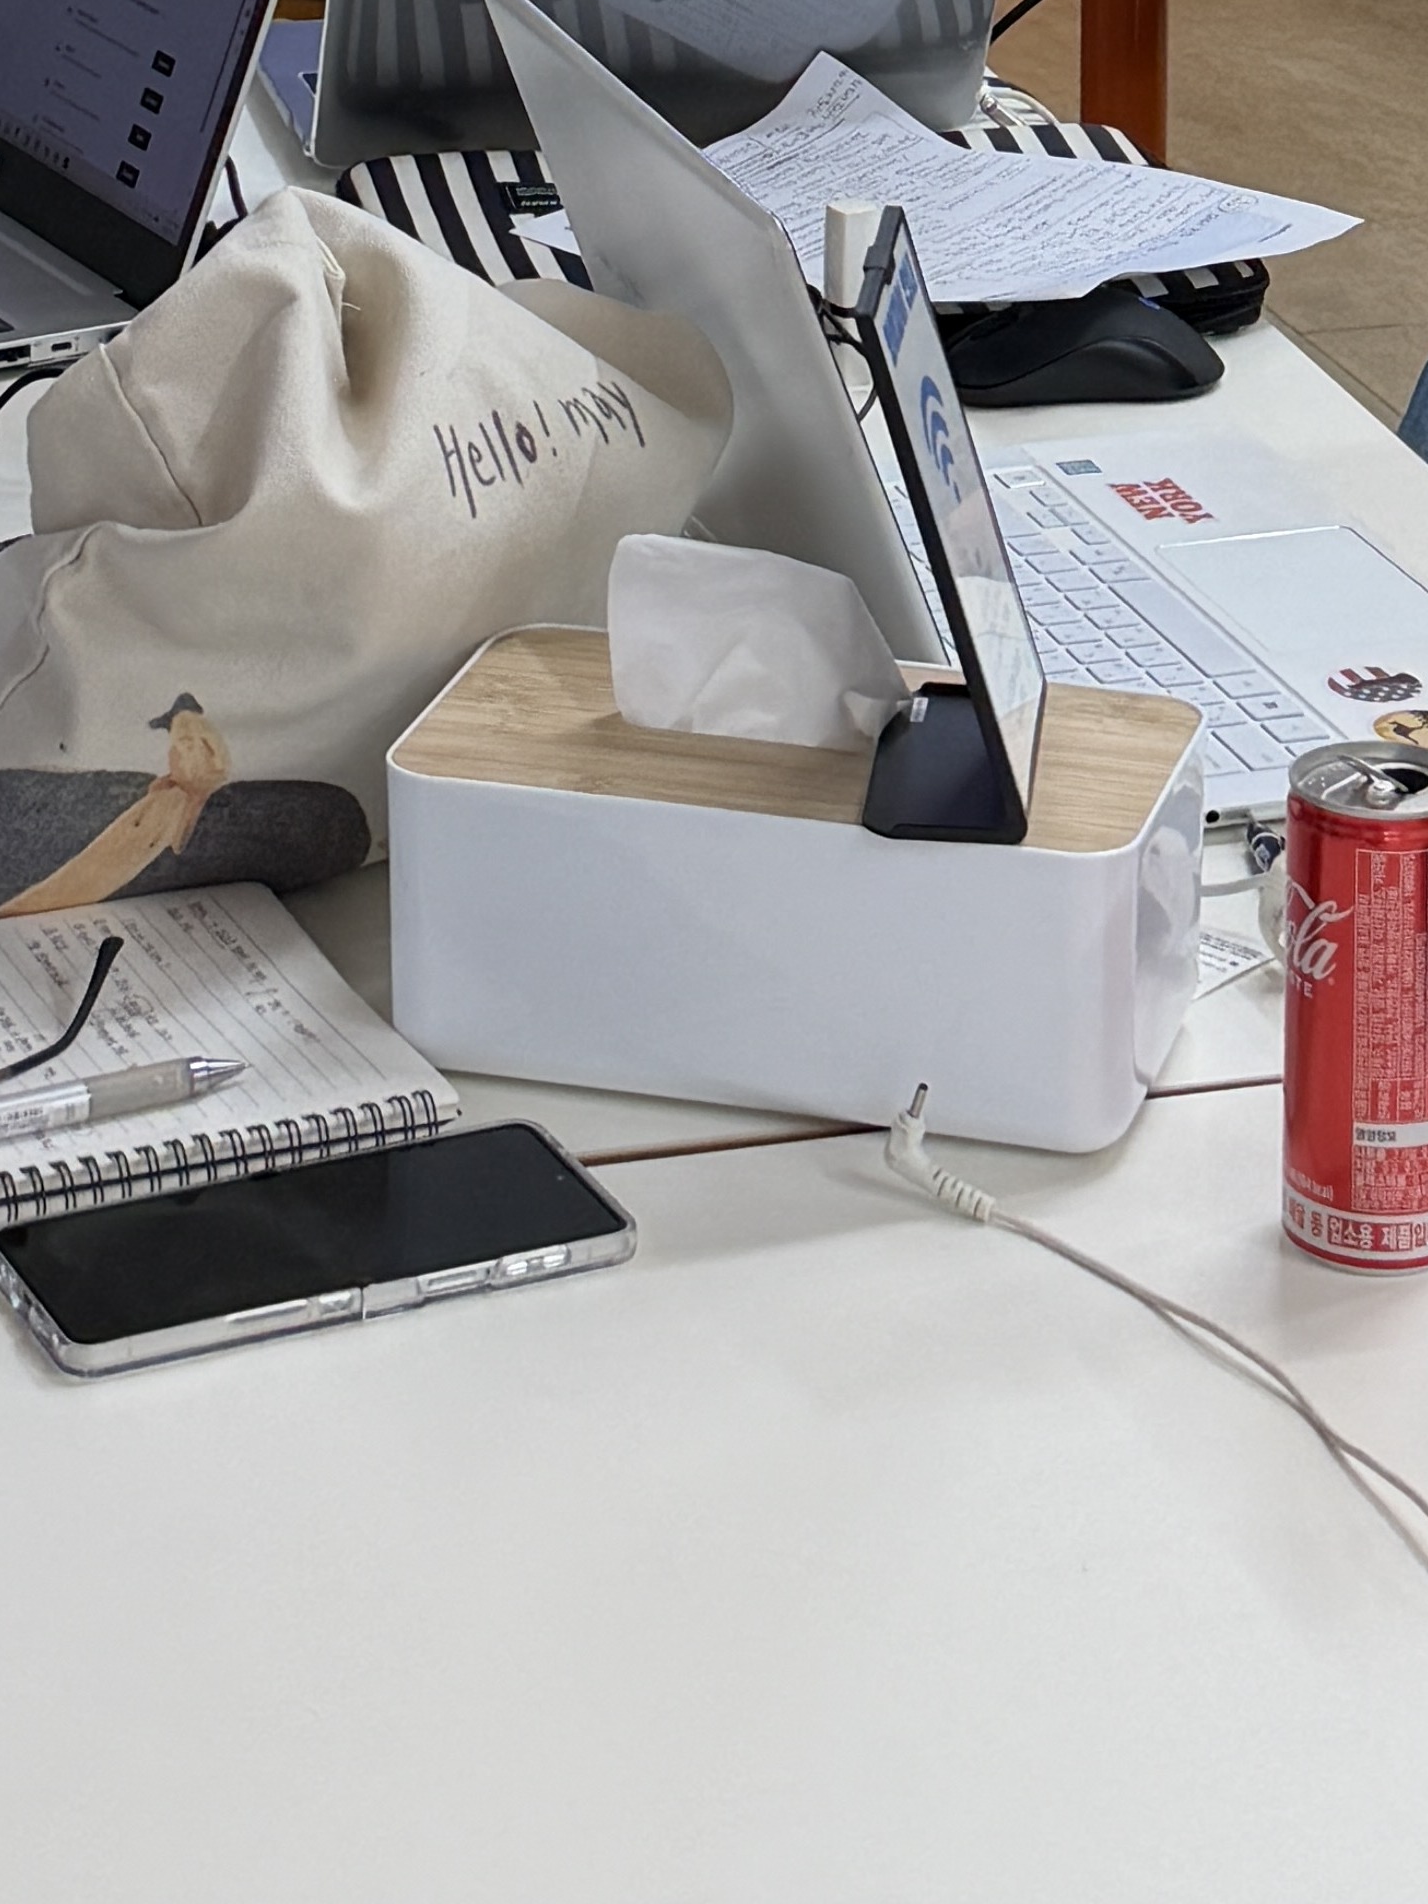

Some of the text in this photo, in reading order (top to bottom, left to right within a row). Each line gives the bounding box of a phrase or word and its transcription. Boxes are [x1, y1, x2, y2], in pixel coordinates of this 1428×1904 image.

[432, 400, 557, 519] Hello!
[1107, 483, 1175, 520] NEW
[1143, 477, 1214, 524] YORK
